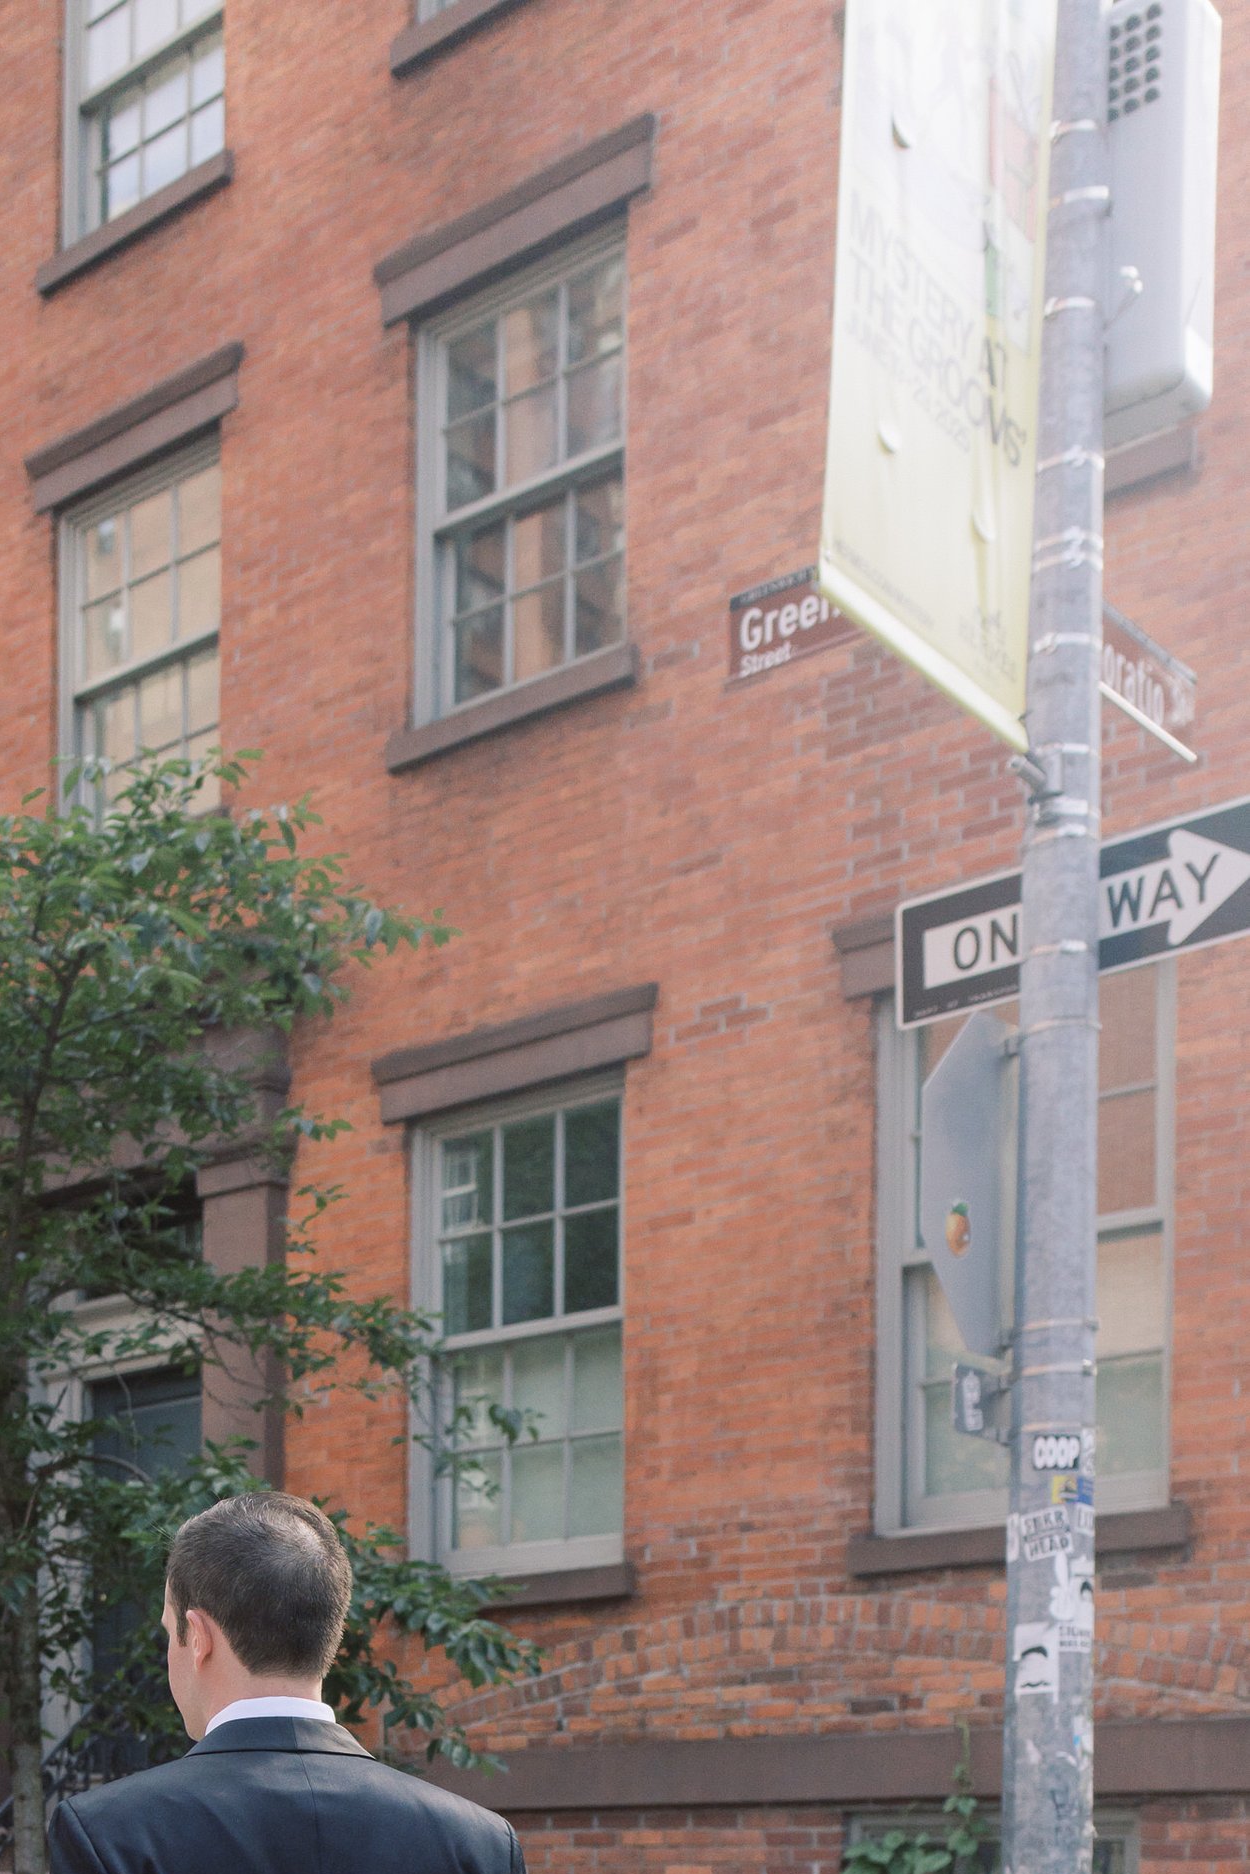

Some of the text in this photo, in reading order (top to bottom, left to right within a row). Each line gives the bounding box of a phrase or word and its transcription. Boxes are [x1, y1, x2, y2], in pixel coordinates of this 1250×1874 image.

[738, 640, 792, 679] Street
[1103, 643, 1164, 726] oratio
[953, 852, 1222, 972] ON WAY
